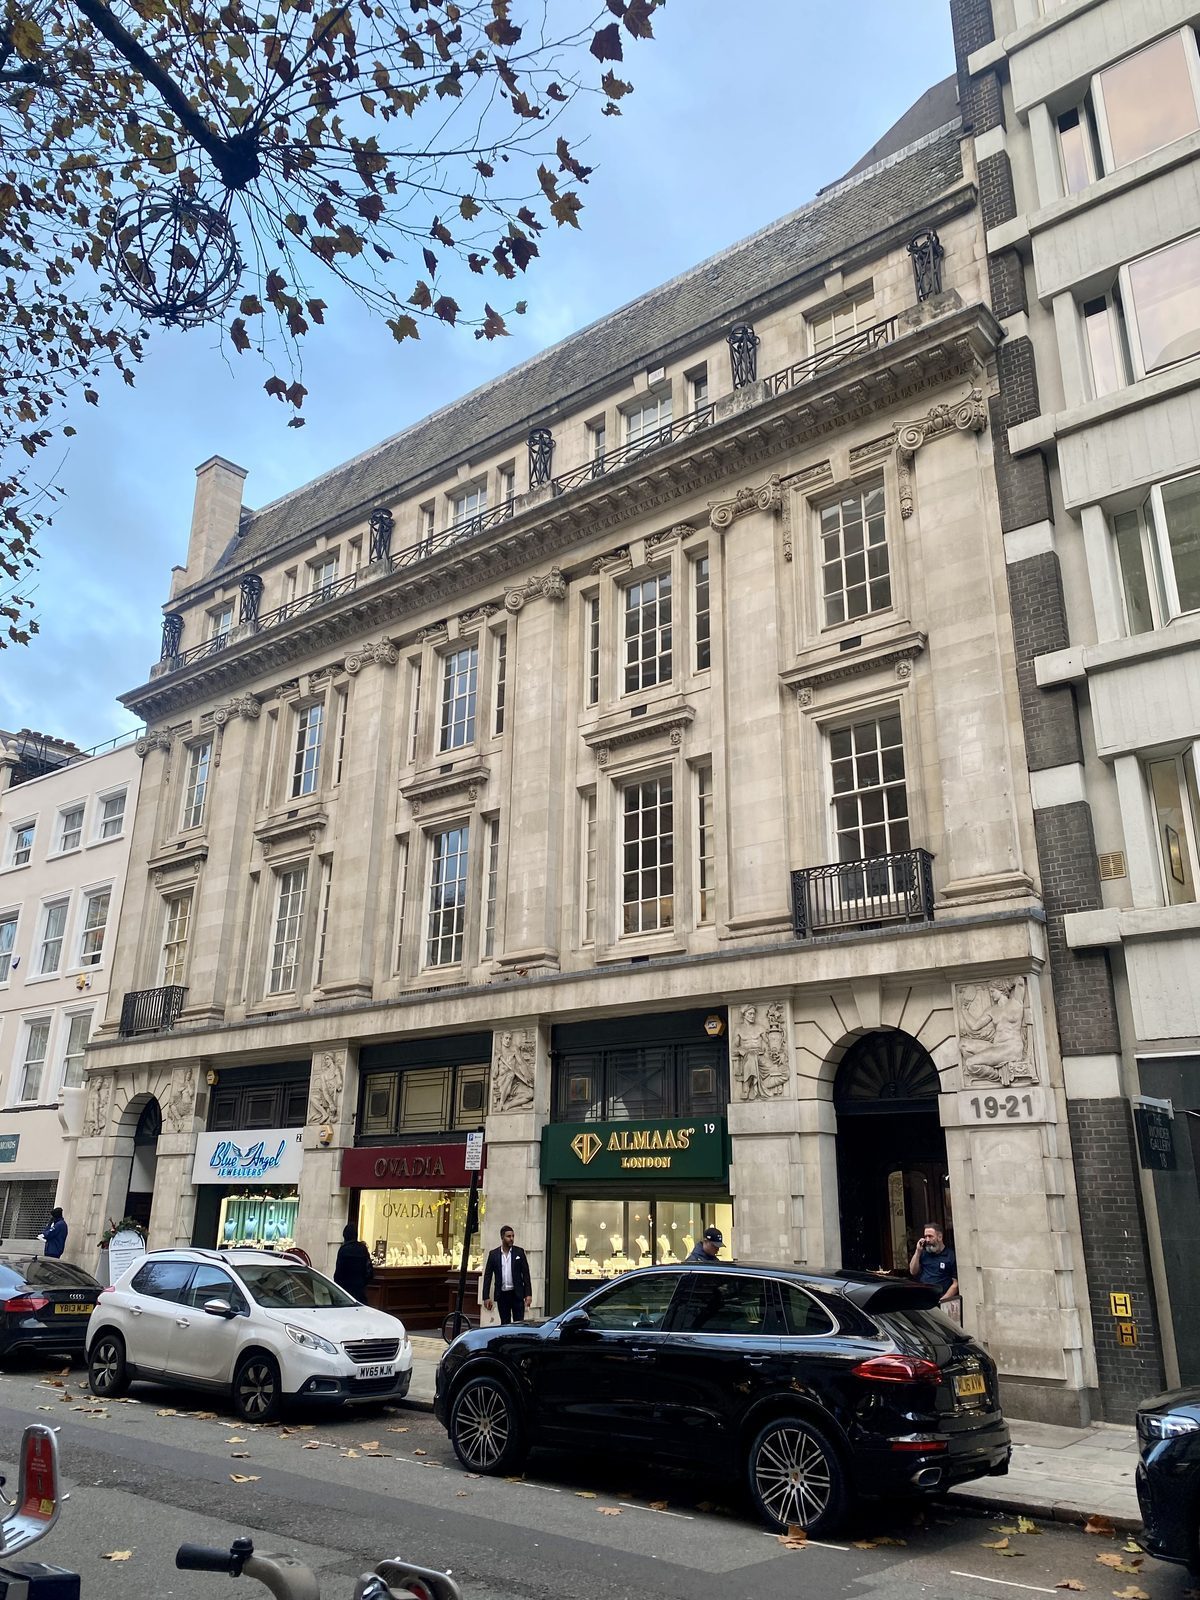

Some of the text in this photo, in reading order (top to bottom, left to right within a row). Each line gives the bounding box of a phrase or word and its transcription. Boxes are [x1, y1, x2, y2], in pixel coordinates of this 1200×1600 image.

[970, 1094, 1033, 1119] 19-21
[703, 1123, 716, 1134] 19
[209, 1139, 287, 1171] Blue Angel
[620, 1156, 672, 1169] LONDON
[217, 1168, 263, 1177] JEWELLERS
[374, 1157, 445, 1177] OVADIA
[382, 1203, 434, 1219] OVADIA
